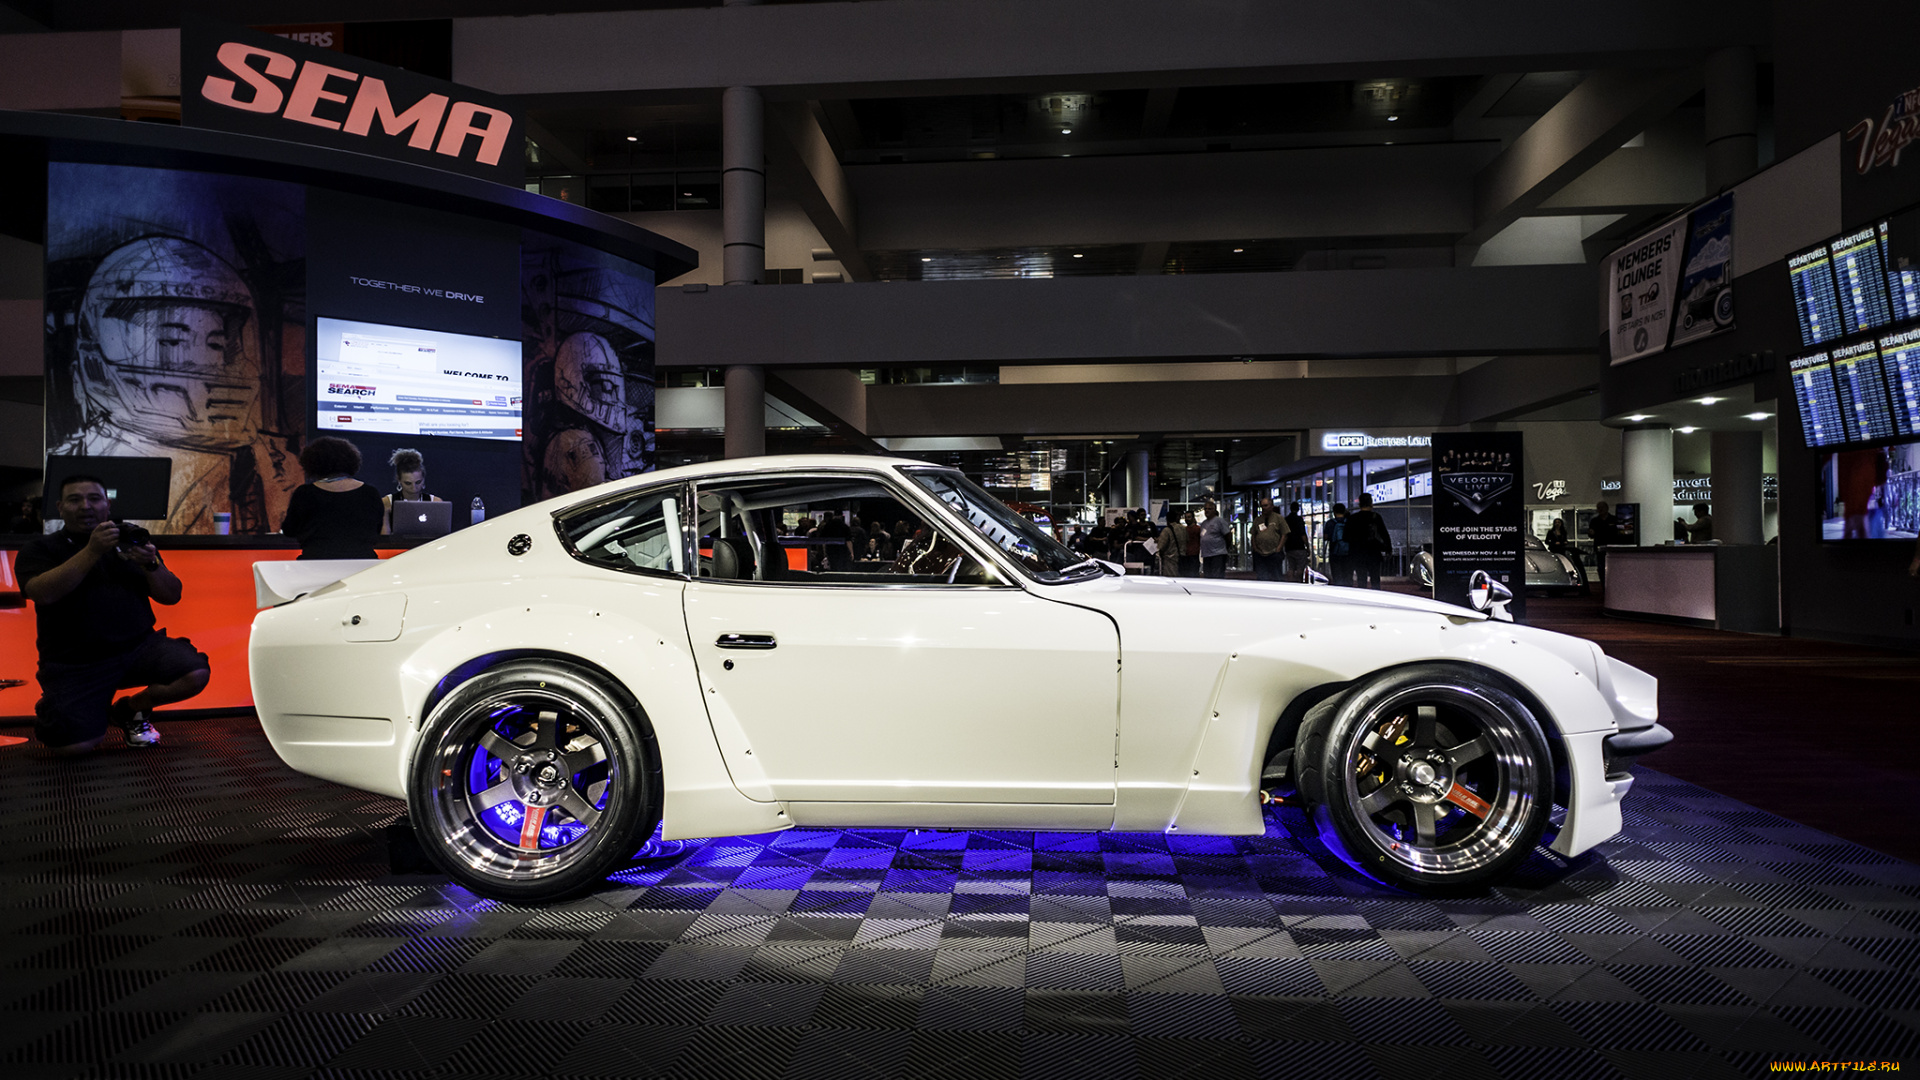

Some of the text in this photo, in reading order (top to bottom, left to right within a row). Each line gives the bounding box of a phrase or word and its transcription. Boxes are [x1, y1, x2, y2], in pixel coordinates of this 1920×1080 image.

[201, 42, 513, 166] SEMA
[1846, 98, 1920, 175] Vega
[1831, 227, 1875, 251] DEPARTURES
[1617, 229, 1676, 274] MEMBERS'
[1788, 246, 1828, 268] DEPARTURES
[1617, 259, 1663, 293] LOUNGE
[350, 276, 485, 304] TOGETHER WE DRIVE
[1789, 352, 1829, 369] DEPARTURES
[1832, 341, 1875, 359] DEPARTURES
[328, 387, 376, 397] SEARCH
[1341, 436, 1363, 447] OPEN
[1408, 435, 1432, 447] Loun
[1532, 481, 1568, 501] Vegas
[1601, 480, 1621, 490] Las
